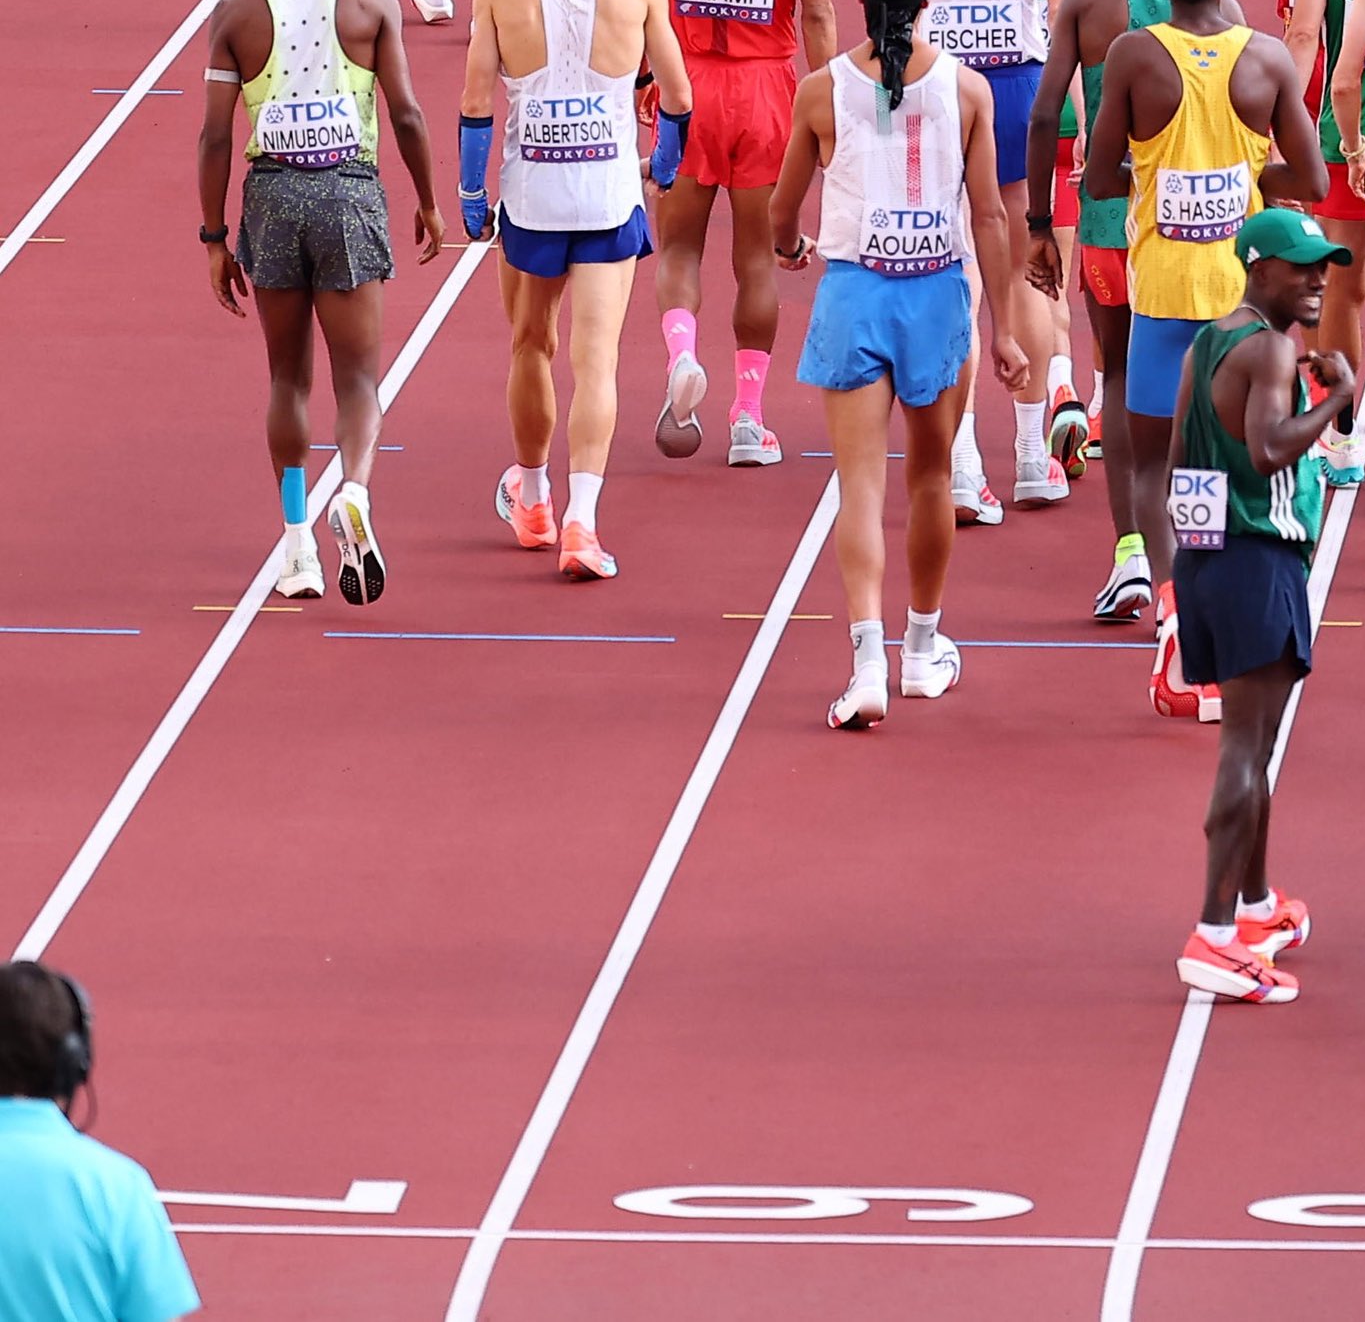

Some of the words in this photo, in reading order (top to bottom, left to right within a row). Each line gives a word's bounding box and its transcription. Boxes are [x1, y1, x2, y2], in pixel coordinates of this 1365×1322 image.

[949, 5, 1012, 24] TDK
[929, 28, 1016, 50] FISCHER
[285, 97, 347, 121] TDK
[543, 94, 605, 118] TDK
[263, 123, 356, 152] NIMUBONA
[524, 118, 613, 144] ALBERTSON
[1183, 170, 1242, 195] TDK
[890, 209, 948, 229] TDK
[1162, 205, 1175, 221] S.
[1179, 196, 1247, 221] HASSAN
[867, 232, 949, 255] AOUANI
[1175, 475, 1218, 498] DK
[613, 1185, 1034, 1222] 6
